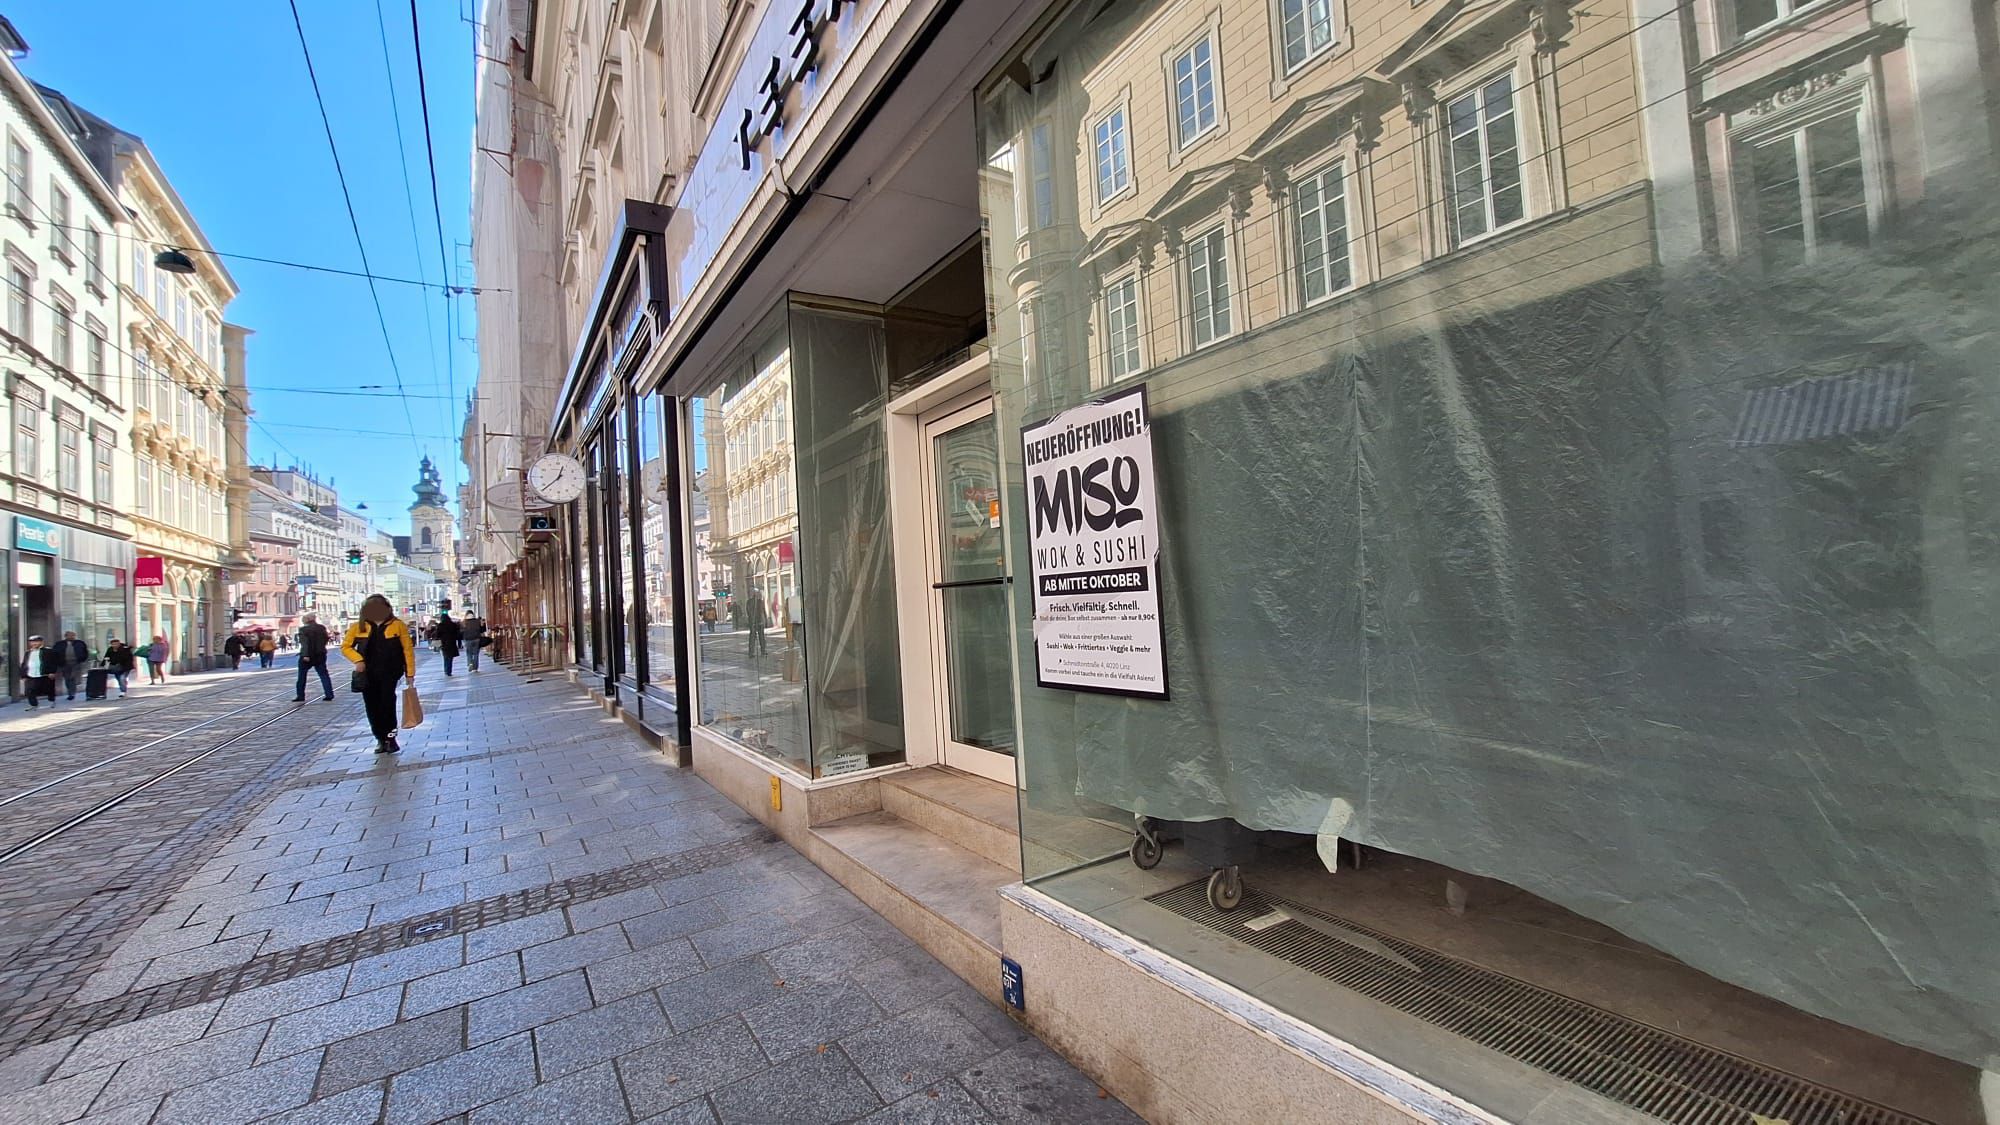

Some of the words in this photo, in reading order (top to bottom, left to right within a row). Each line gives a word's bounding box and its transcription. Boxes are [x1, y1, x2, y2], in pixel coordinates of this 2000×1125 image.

[1026, 407, 1142, 466] NEUERÖFFNUNG!
[1033, 455, 1143, 539] MISO
[1037, 546, 1068, 570] WOK
[1076, 543, 1085, 566] &
[1094, 535, 1146, 564] SUSHI
[1044, 579, 1057, 592] AB
[1059, 576, 1088, 591] MITTE
[1089, 572, 1142, 589] OKTOBER
[1050, 603, 1072, 612] Frisch.
[1072, 601, 1108, 613] Vielfältig.
[1108, 600, 1140, 611] Schnell.
[1062, 642, 1074, 650] Wok
[1109, 644, 1128, 653] Veggie
